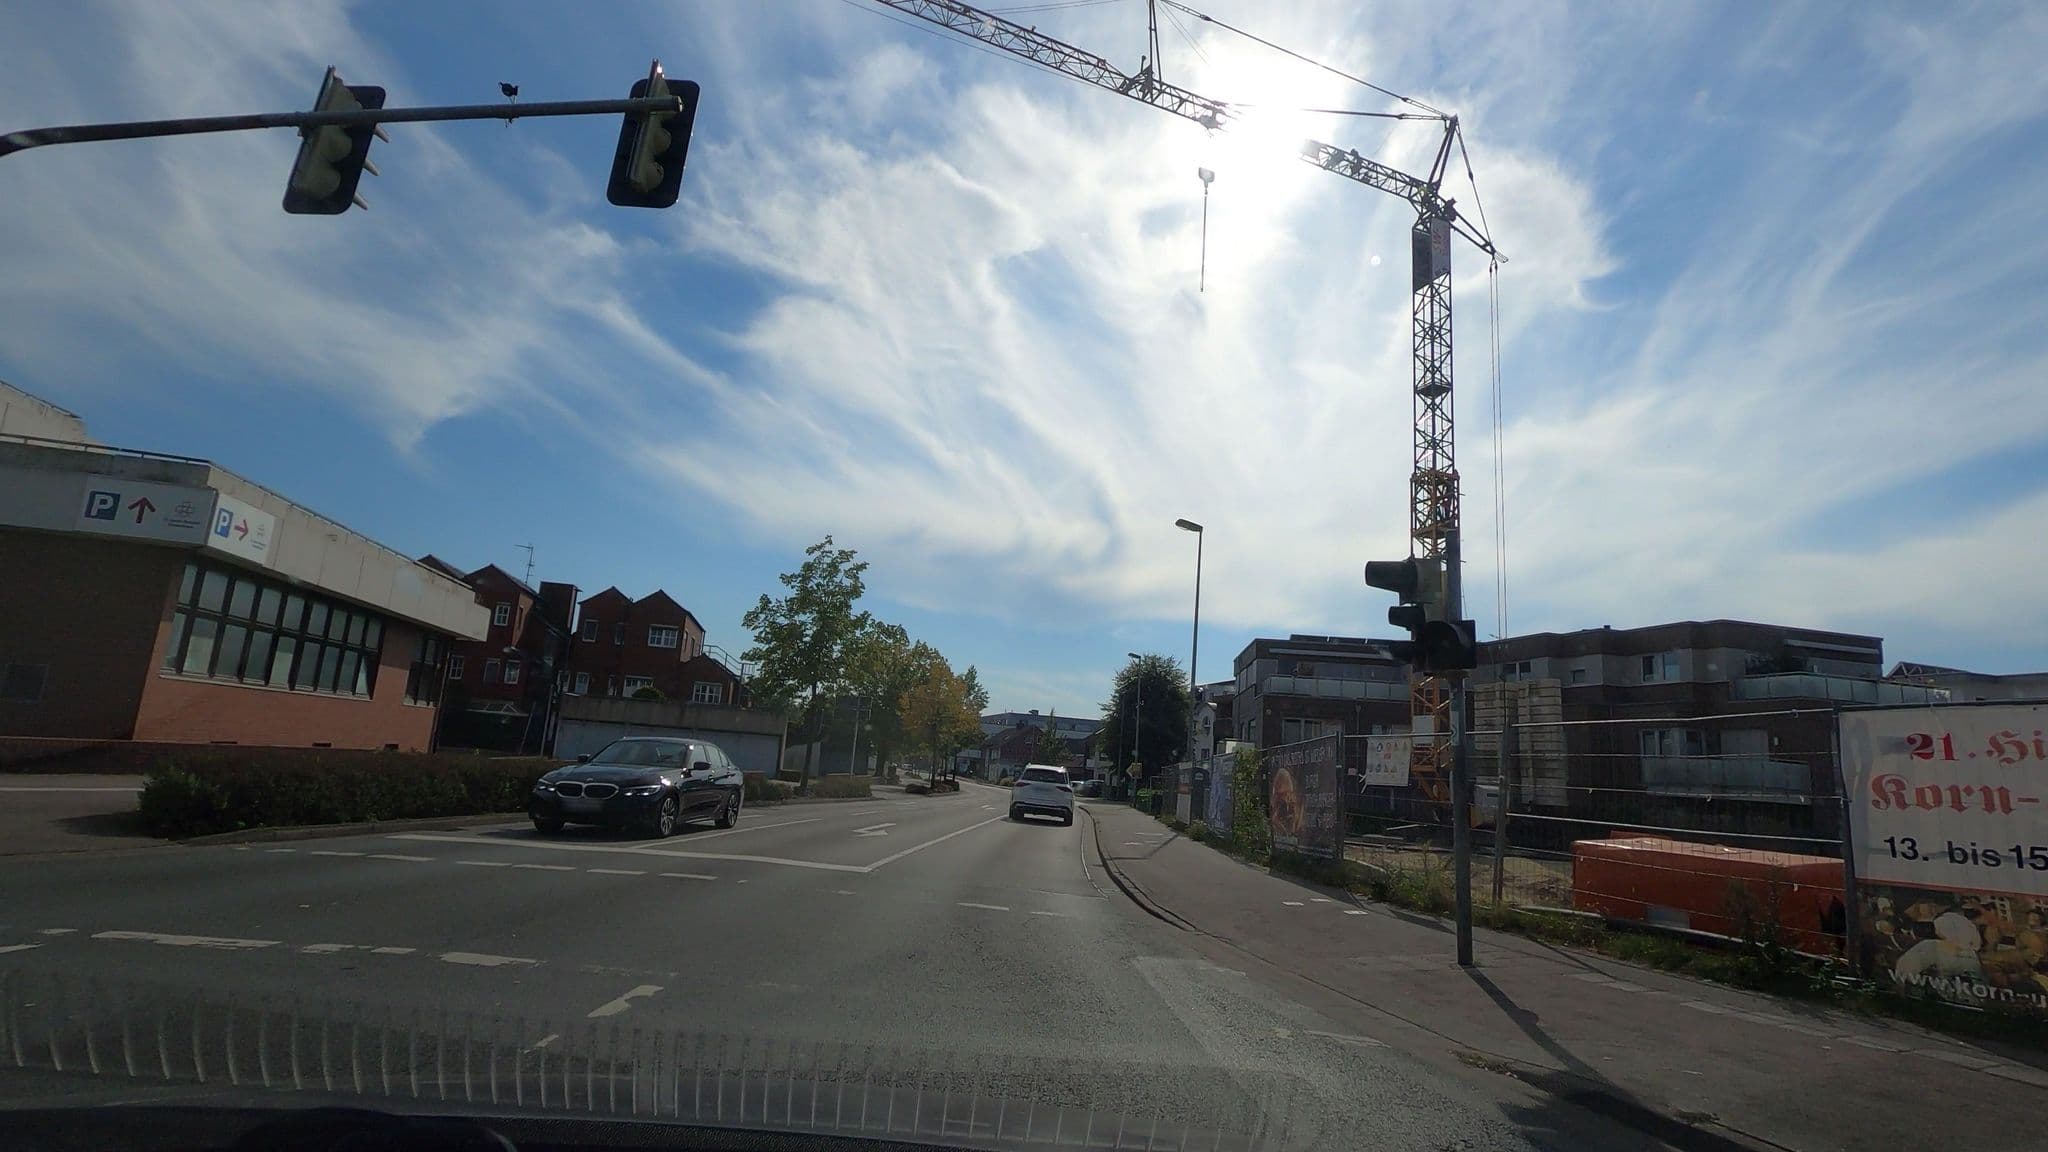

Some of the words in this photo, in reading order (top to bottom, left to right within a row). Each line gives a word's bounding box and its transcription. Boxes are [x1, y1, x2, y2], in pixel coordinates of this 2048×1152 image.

[92, 494, 115, 516] P
[216, 511, 231, 534] P
[1906, 732, 1976, 761] 21.
[1872, 773, 2040, 815] Korn-
[1884, 836, 1930, 861] 13.
[1947, 840, 2002, 867] bis
